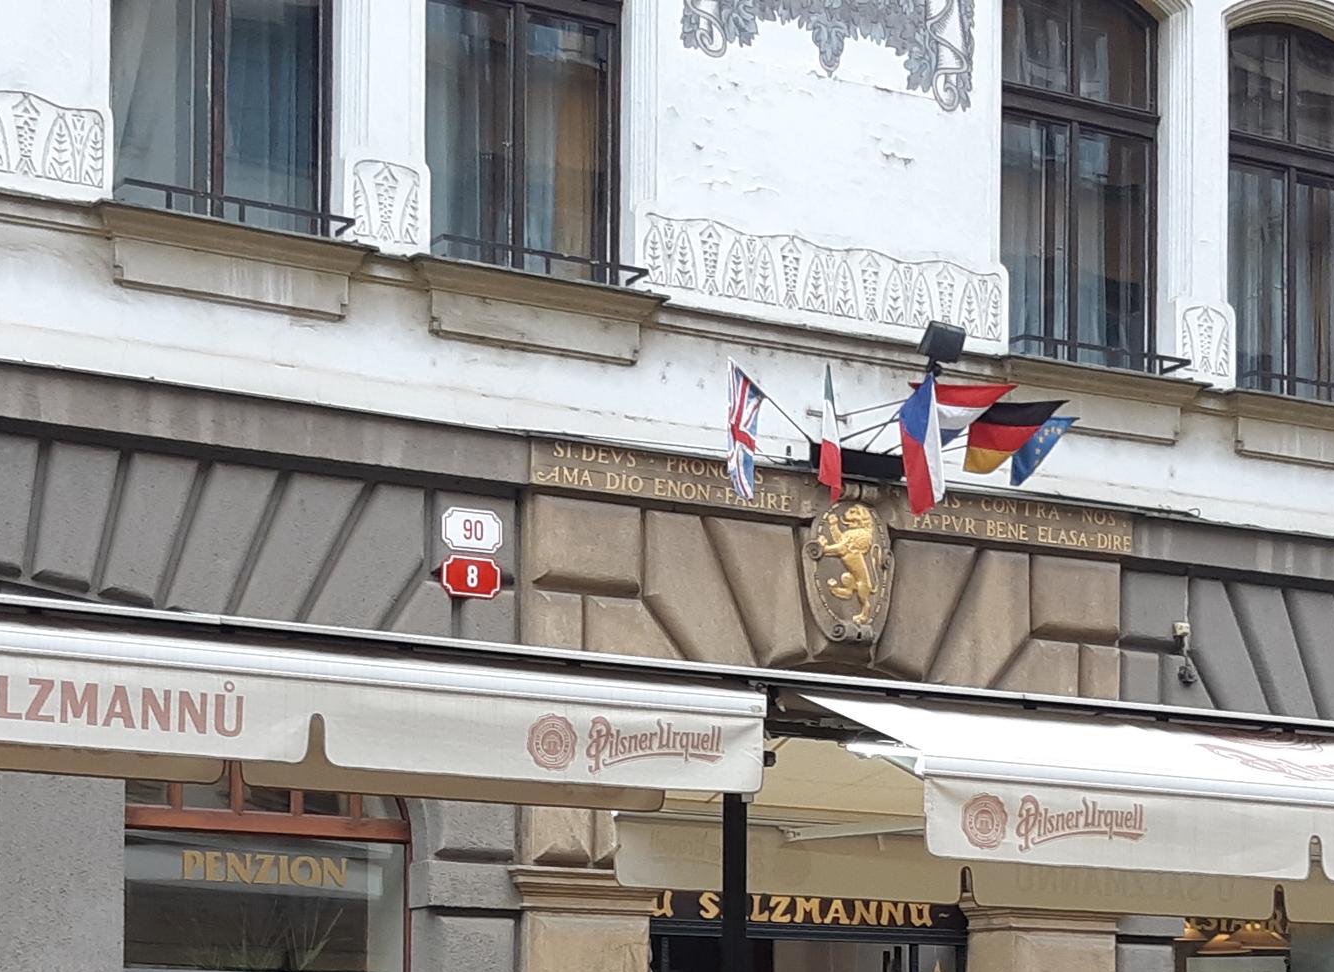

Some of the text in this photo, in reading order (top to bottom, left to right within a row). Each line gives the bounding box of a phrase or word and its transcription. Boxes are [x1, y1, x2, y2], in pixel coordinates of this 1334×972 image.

[537, 467, 593, 486] AMA
[981, 498, 1060, 520] CONTRA
[463, 518, 484, 541] 90
[986, 519, 1029, 541] BENE
[466, 564, 479, 588] 8
[586, 716, 723, 774] Pilsner Urquell
[1016, 795, 1144, 853] Pilsner Urquell
[181, 850, 349, 888] PENZION
[651, 889, 674, 918] U
